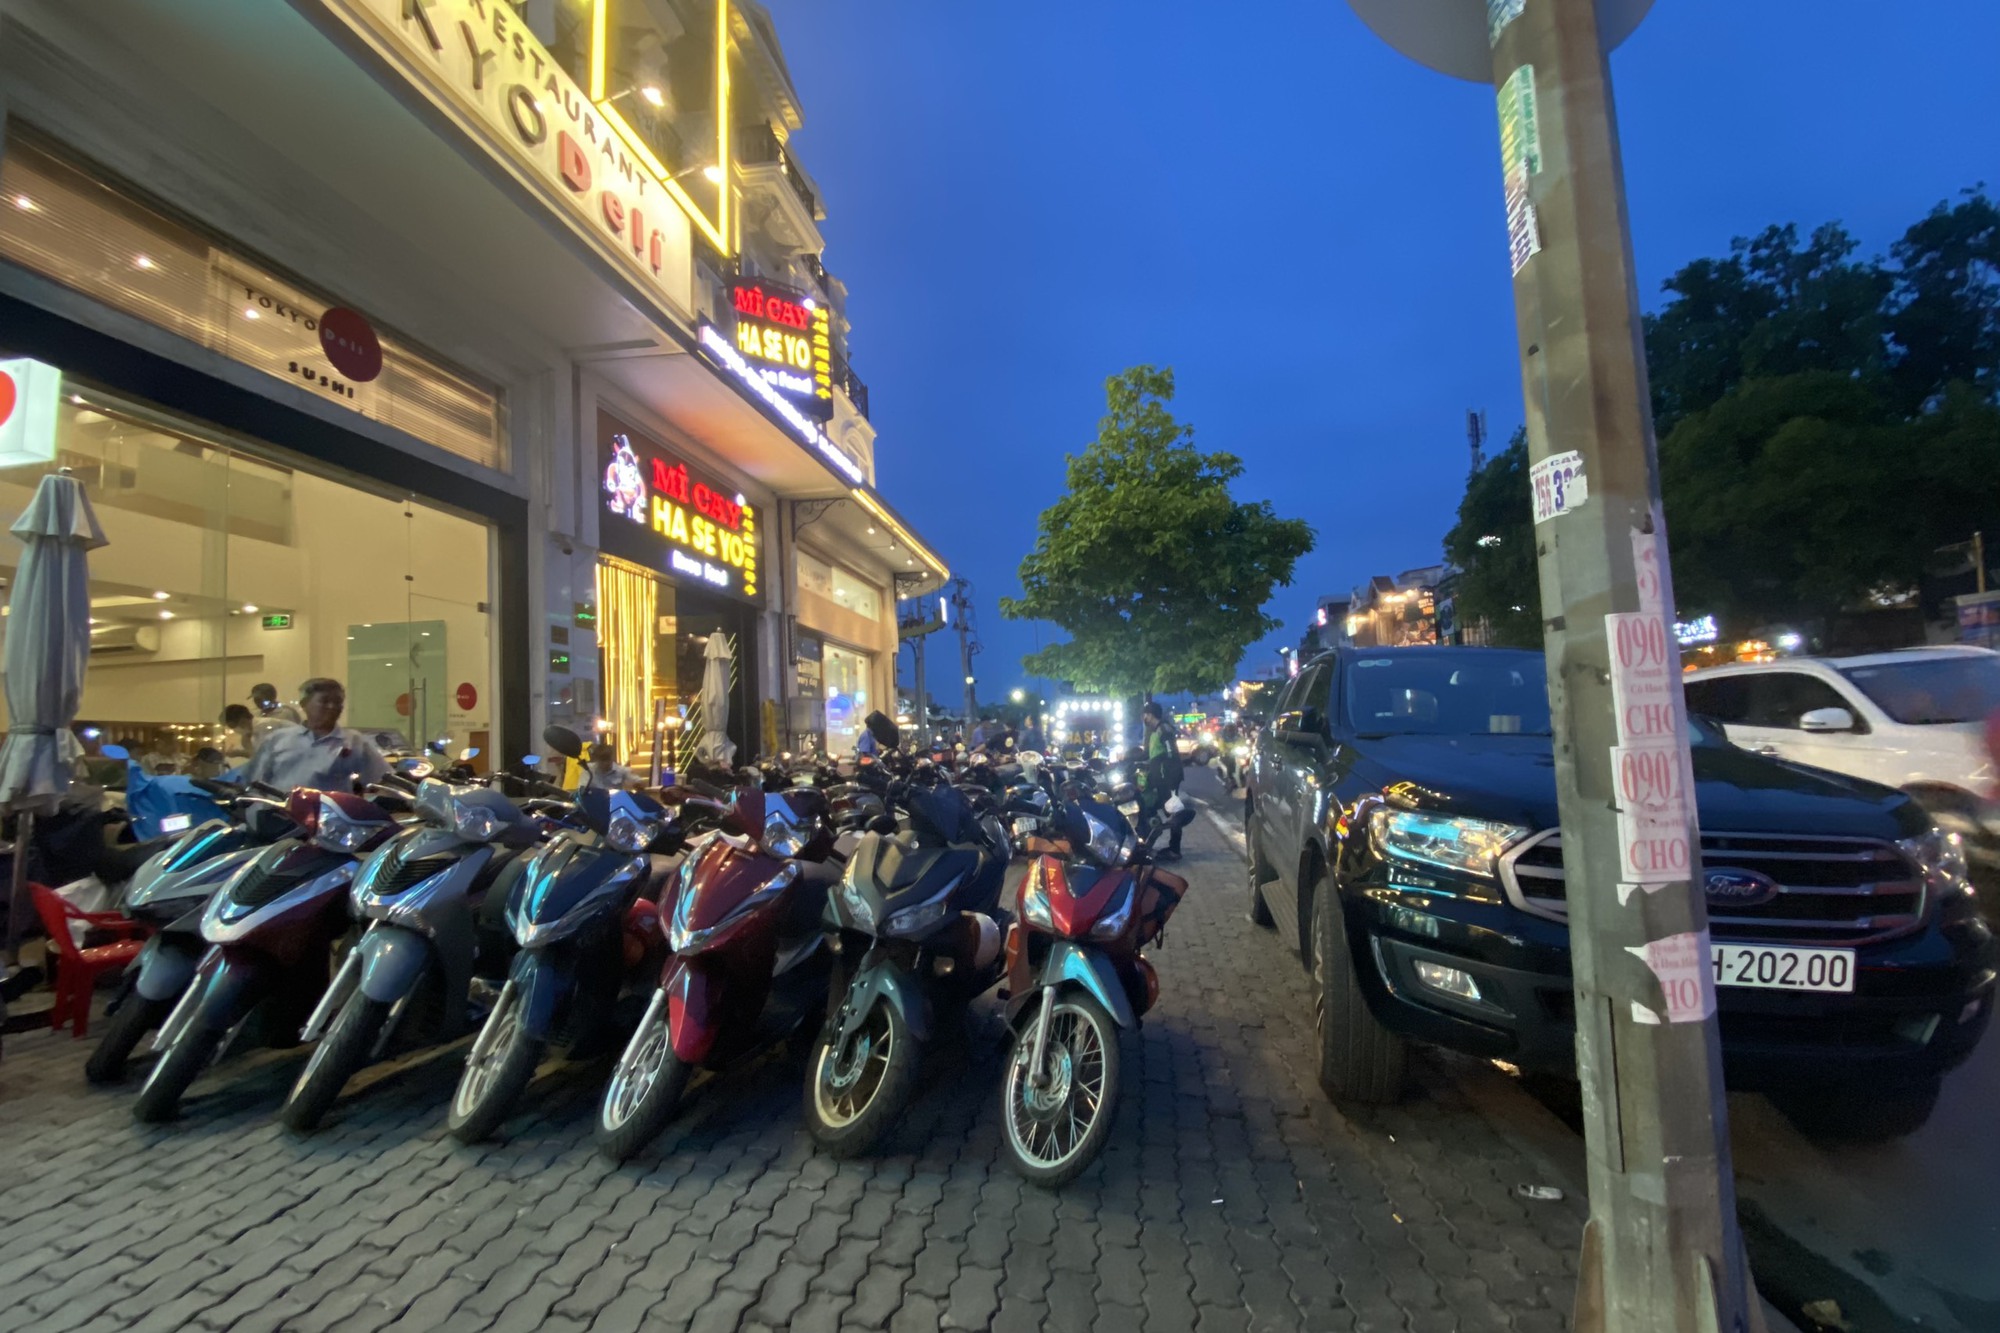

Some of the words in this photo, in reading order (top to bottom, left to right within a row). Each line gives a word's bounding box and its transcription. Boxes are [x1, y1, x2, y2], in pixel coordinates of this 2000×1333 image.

[559, 130, 662, 271] Deli
[246, 287, 316, 331] TOKYO
[766, 296, 811, 331] CAY
[288, 361, 354, 398] SUSHI
[652, 457, 690, 503] MÌ
[692, 481, 743, 530] CAY
[1630, 838, 1689, 871] CHO
[1706, 875, 1756, 896] Ford
